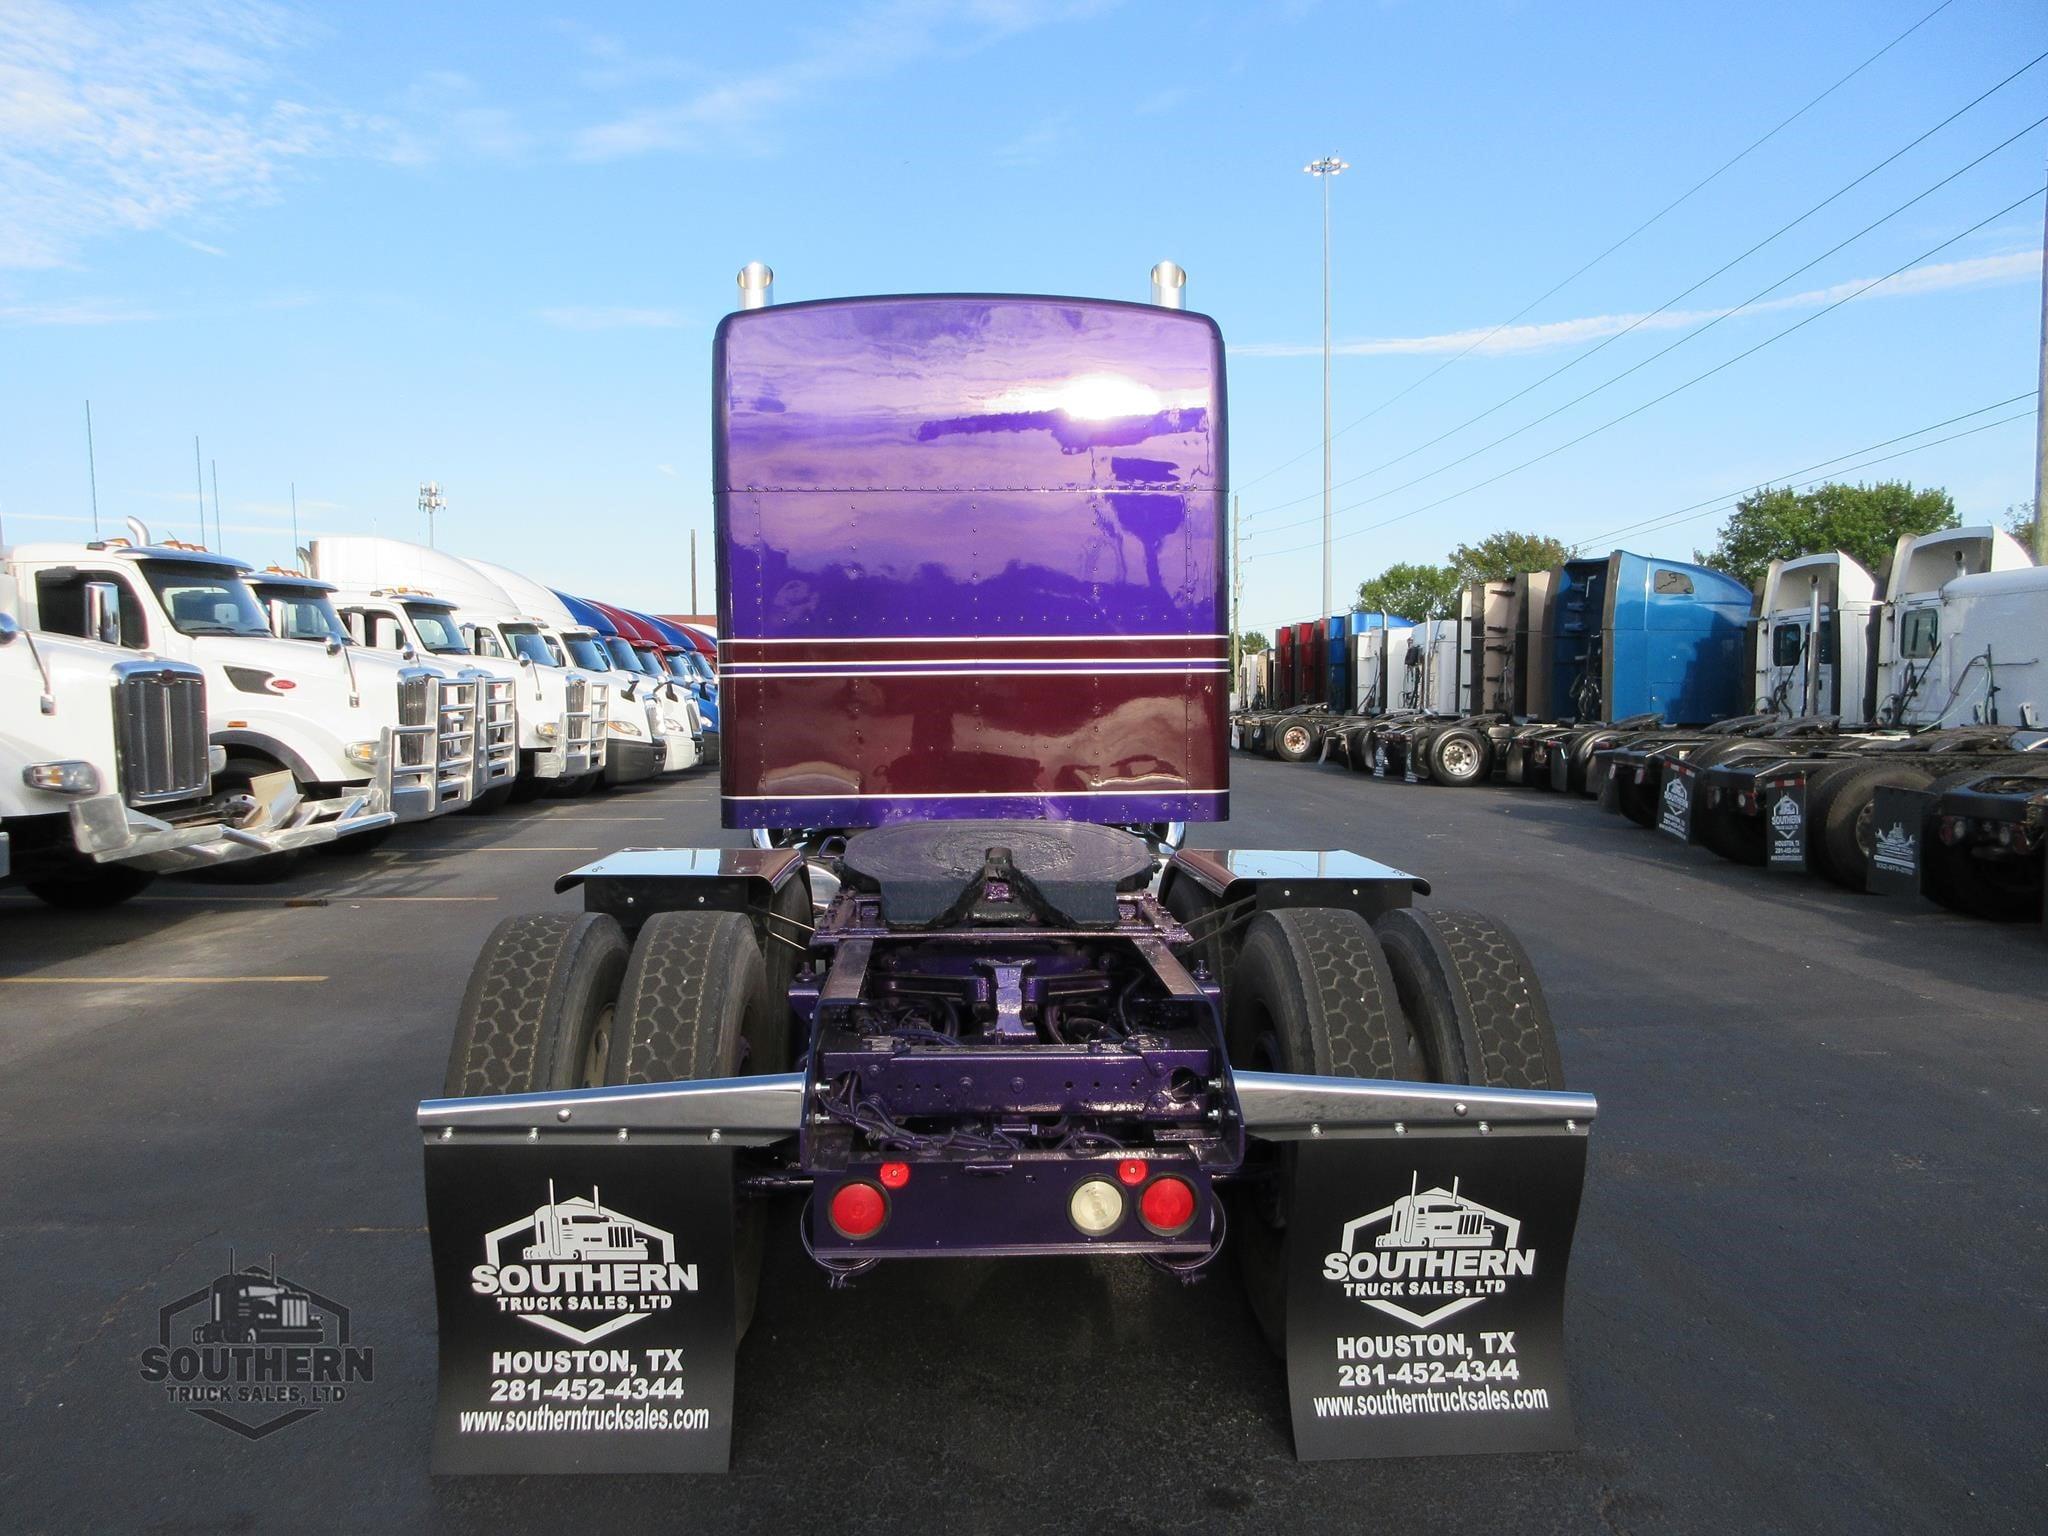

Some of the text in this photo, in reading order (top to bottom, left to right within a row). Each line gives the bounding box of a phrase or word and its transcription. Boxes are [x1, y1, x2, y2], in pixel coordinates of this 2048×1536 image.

[471, 1263, 699, 1294] SOUTHERN
[1322, 1248, 1536, 1281] SOUTHERN
[1343, 1279, 1506, 1297] TRUCK SALES, LTD
[496, 1294, 672, 1313] TRUCK SALES, LTD
[1336, 1331, 1516, 1360] HOUSTON, TX
[492, 1349, 684, 1377] HOUSTON, TX
[1338, 1359, 1520, 1387] 281-452-4344
[489, 1377, 685, 1402] 281-452-4344
[1313, 1384, 1549, 1417] www.southerntrucksales.com
[460, 1402, 709, 1432] www.southerntrucksales.com
